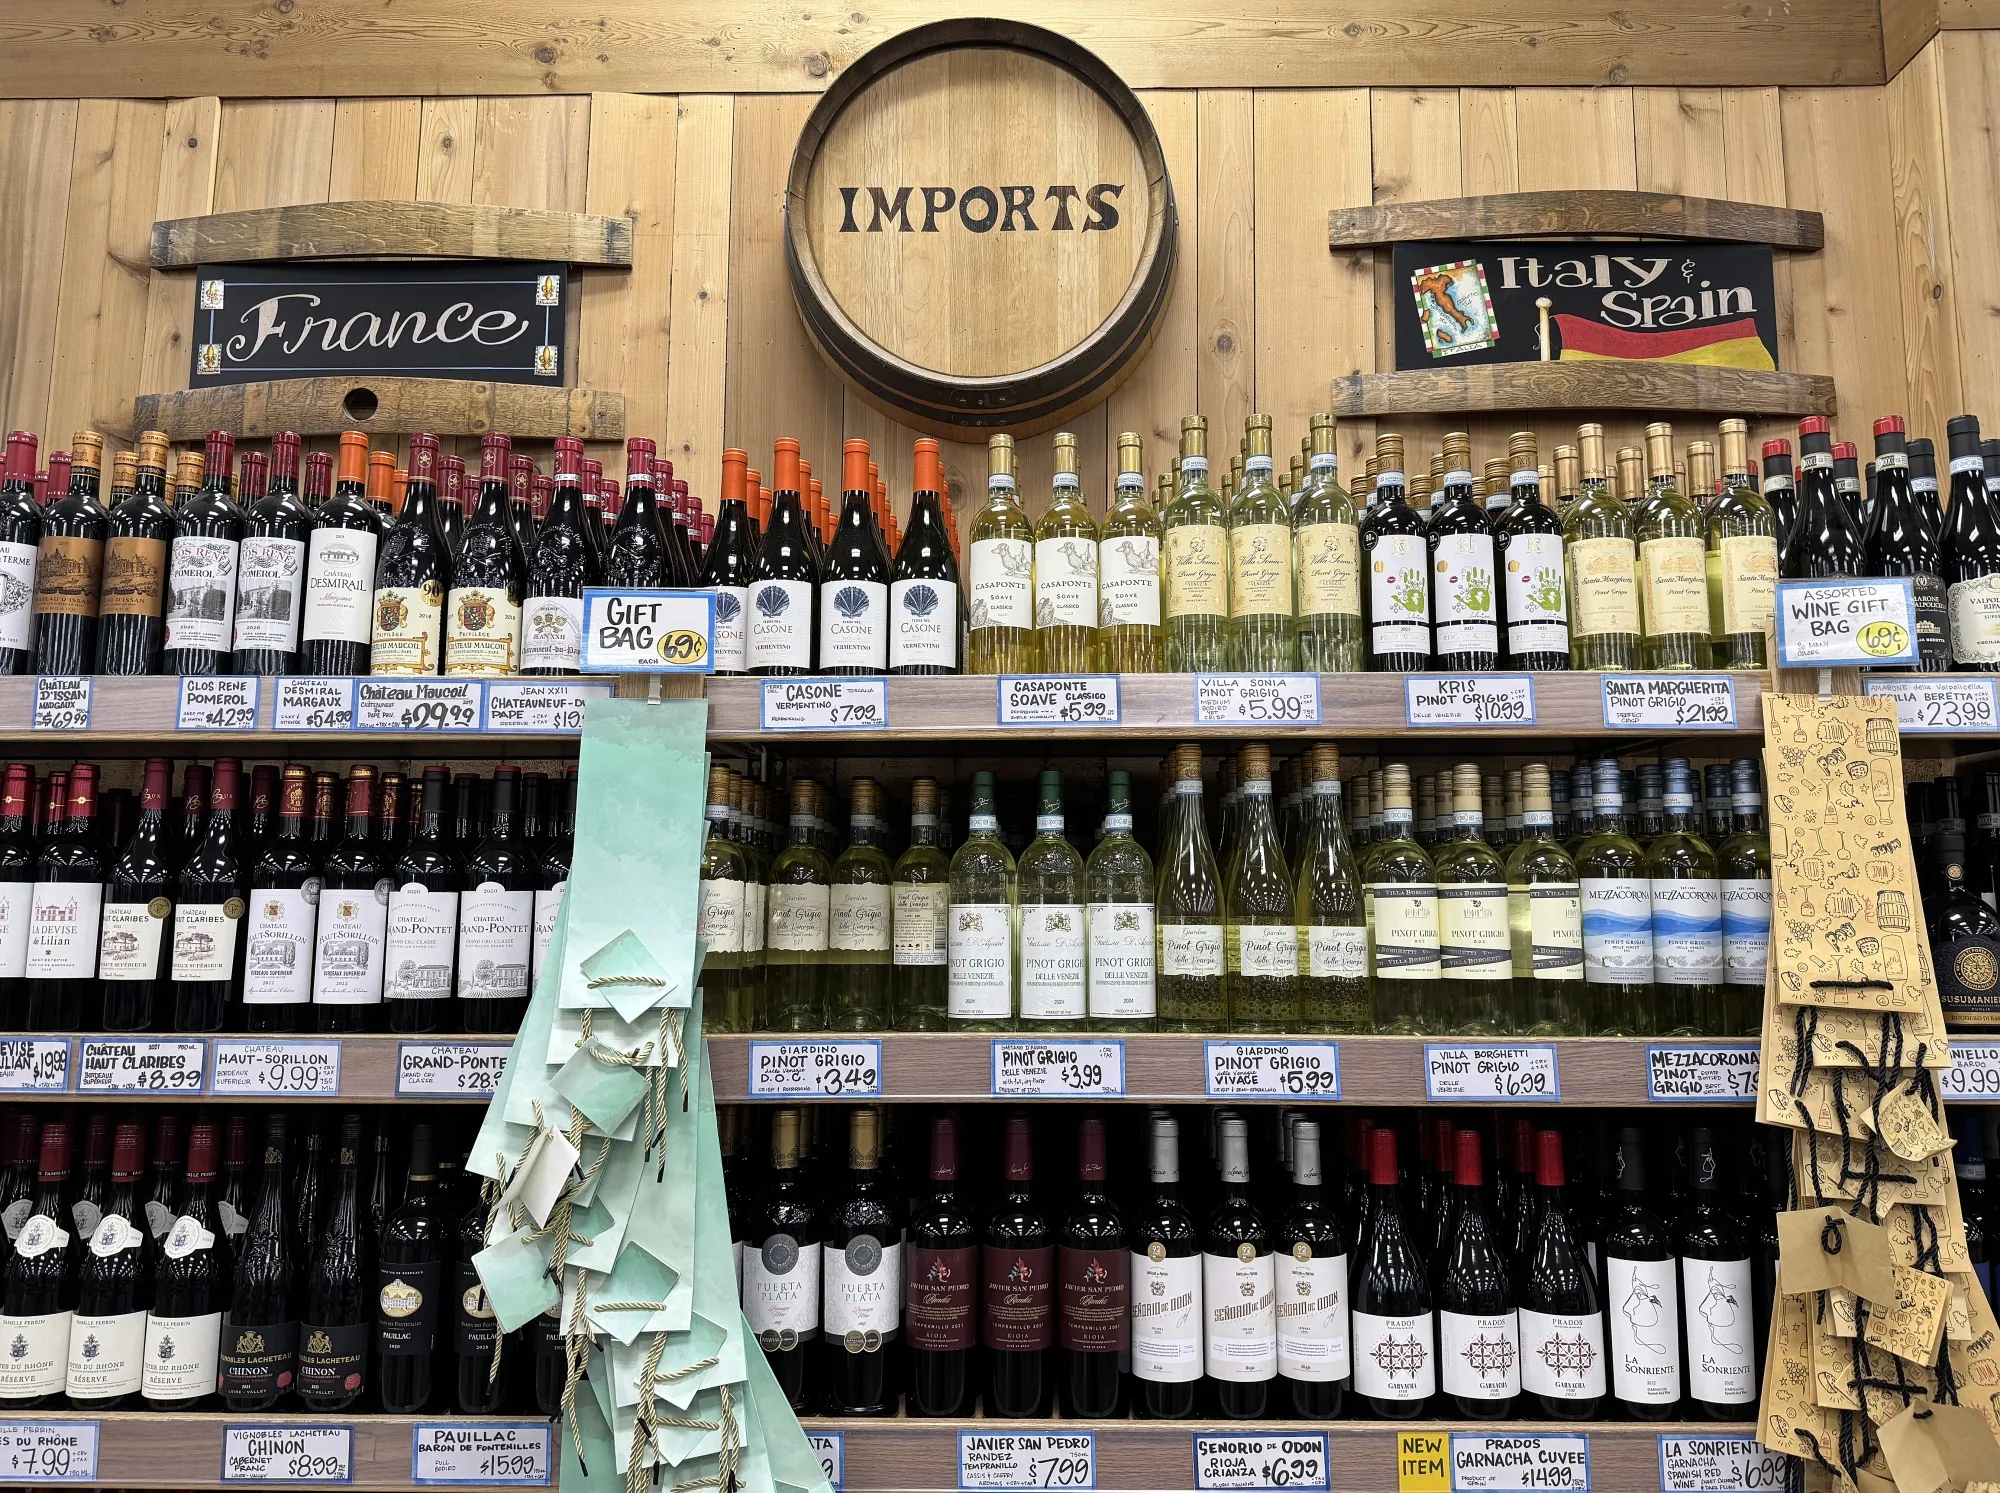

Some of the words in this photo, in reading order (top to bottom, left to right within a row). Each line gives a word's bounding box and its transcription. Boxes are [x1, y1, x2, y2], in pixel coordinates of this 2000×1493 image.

[839, 183, 1125, 234] IMPORTS
[1498, 254, 1672, 288] Italy
[1602, 279, 1758, 329] Spain
[226, 293, 529, 362] France
[1442, 343, 1483, 356] ITALIA
[975, 580, 1027, 591] CASAPONTE
[1040, 580, 1093, 590] CASAPONTE
[1101, 579, 1153, 590] CASAPONTE
[422, 584, 440, 598] 90
[1803, 586, 1877, 601] ASSORTED
[607, 597, 662, 626] GIFT
[1791, 601, 1841, 620] WINE
[1847, 599, 1888, 614] GIFT
[753, 623, 793, 635] CASONE
[830, 623, 873, 635] CASONE
[900, 622, 941, 633] CASONE
[1810, 619, 1850, 637] BAG
[387, 642, 421, 650] MAUCOIL
[599, 625, 654, 651] BAG
[664, 634, 702, 659] 69¢
[39, 678, 81, 691] CHÂTEAU
[187, 680, 215, 691] CLOS
[218, 681, 248, 691] RENE
[1014, 682, 1087, 692] CASAPONTE
[1202, 679, 1239, 687] VILLA
[1250, 679, 1286, 687] SONIA
[1438, 680, 1476, 694] KRIS
[1606, 681, 1645, 695] SANTA
[1648, 681, 1730, 695] MARGHERITA
[1936, 684, 1984, 692] Valpolicella
[40, 690, 87, 701] D'ISSAN
[284, 686, 342, 695] DESMIRAL
[416, 684, 469, 699] Maucoil
[521, 687, 545, 696] JEAN
[548, 687, 568, 695] XXII
[786, 684, 842, 702] CASONE
[1200, 688, 1234, 698] PINOT
[1240, 688, 1279, 698] GRIGIO
[187, 693, 248, 705] POMEROL
[283, 697, 342, 708] MARGAUX
[1010, 693, 1057, 707] SOAVE
[1065, 693, 1106, 701] CLASSICO
[1416, 695, 1457, 706] PINOT
[1462, 693, 1509, 706] GRIGIO
[1611, 697, 1645, 707] PINOT
[1647, 697, 1687, 707] GRIGIO
[1924, 693, 1973, 701] BERETTA
[39, 702, 76, 710] MARGAUX
[776, 701, 832, 710] VERMENTINO
[1238, 696, 1301, 721] $5.99
[491, 710, 525, 720] PAPE
[1060, 702, 1105, 722] $5.99
[1675, 704, 1728, 724] $21.99
[1917, 701, 1991, 727] $23.99
[1588, 890, 1650, 902] MEZZACORONA
[1653, 890, 1718, 902] MEZZACORONA
[111, 914, 150, 923] CLARIBES
[186, 915, 226, 924] CLARIBES
[40, 924, 78, 934] DEVISE
[40, 935, 70, 946] Lilian
[968, 958, 1005, 969] GRIGIO
[1026, 958, 1055, 969] PINOT
[1094, 957, 1125, 968] PINOT
[85, 1044, 135, 1057] CHÂTEAU
[431, 1046, 479, 1054] CHATEAU
[780, 1046, 838, 1055] GIARDINO
[1236, 1046, 1289, 1056] GIARDINO
[1439, 1051, 1468, 1060] VILLA
[1474, 1049, 1529, 1059] BORGHETTI
[85, 1057, 118, 1070] HAUT
[122, 1056, 186, 1070] CLARIBES
[218, 1053, 328, 1065] HAUT-SORILLON
[760, 1055, 808, 1069] PINOT
[815, 1054, 865, 1067] GRIGIO
[1002, 1051, 1036, 1068] PINOT
[1037, 1050, 1077, 1065] GRIGIO
[1215, 1056, 1263, 1070] PINOT
[1269, 1056, 1321, 1069] GRIGIO
[1651, 1051, 1761, 1068] MEZZACORONA
[1001, 1068, 1020, 1076] DELLE
[1020, 1067, 1048, 1075] VENEZIE
[1431, 1061, 1471, 1075] PINOT
[1477, 1061, 1520, 1073] GRIGIO
[137, 1069, 201, 1090] $8.99
[258, 1064, 319, 1090] $9.99
[1061, 1064, 1103, 1090] $3.99
[1215, 1075, 1259, 1085] VIVACE
[1652, 1068, 1698, 1081] PINOT
[1941, 1068, 2000, 1093] $9.99
[815, 1068, 877, 1095] $3.49
[1280, 1070, 1334, 1093] $5.99
[1494, 1072, 1546, 1096] $6.99
[1653, 1080, 1703, 1096] GRIGIO
[757, 1282, 802, 1295] PUERTA
[841, 1282, 886, 1296] PUERTA
[761, 1292, 798, 1302] PLATA
[845, 1292, 881, 1302] PLATA
[247, 1352, 292, 1364] LACHETEAU
[1625, 1354, 1638, 1365] LA
[229, 1366, 269, 1376] CHINON
[1625, 1363, 1674, 1376] SONRIENTE
[16, 1437, 31, 1446] DU
[38, 1434, 78, 1446] RHÔNE
[232, 1430, 283, 1439] VIGNOBLES
[289, 1430, 340, 1438] LACHETEAU
[434, 1430, 516, 1444] PAUILLAC
[247, 1439, 305, 1456] CHINON
[418, 1443, 454, 1453] BARON
[459, 1443, 472, 1451] DE
[476, 1441, 541, 1452] FONTENILLES
[967, 1437, 1015, 1451] JAVIER
[1018, 1437, 1041, 1450] SAN
[1045, 1436, 1090, 1449] PEDRO
[1198, 1440, 1262, 1455] SENORIO
[1281, 1440, 1322, 1453] ODON
[1403, 1437, 1442, 1454] NEW
[1485, 1439, 1541, 1450] PRADOS
[1665, 1442, 1682, 1458] LA
[12, 1448, 70, 1476] $7.99
[229, 1456, 273, 1466] CABERNET
[968, 1452, 1013, 1462] RANDEZ
[1210, 1458, 1247, 1468] RIOJA
[1456, 1451, 1533, 1469] GARNACHA
[1538, 1450, 1585, 1465] CUVEE
[234, 1464, 266, 1472] FRANC
[288, 1454, 339, 1477] $8.99
[963, 1462, 1018, 1470] TEMPRANILLO
[1402, 1457, 1444, 1477] ITEM
[1667, 1457, 1717, 1470] GARNACHA
[1204, 1467, 1257, 1478] CRIANZA
[1261, 1457, 1318, 1486] $6.99
[1667, 1469, 1702, 1481] SPANISH
[1704, 1468, 1721, 1477] RED
[1673, 1479, 1695, 1489] WINE
